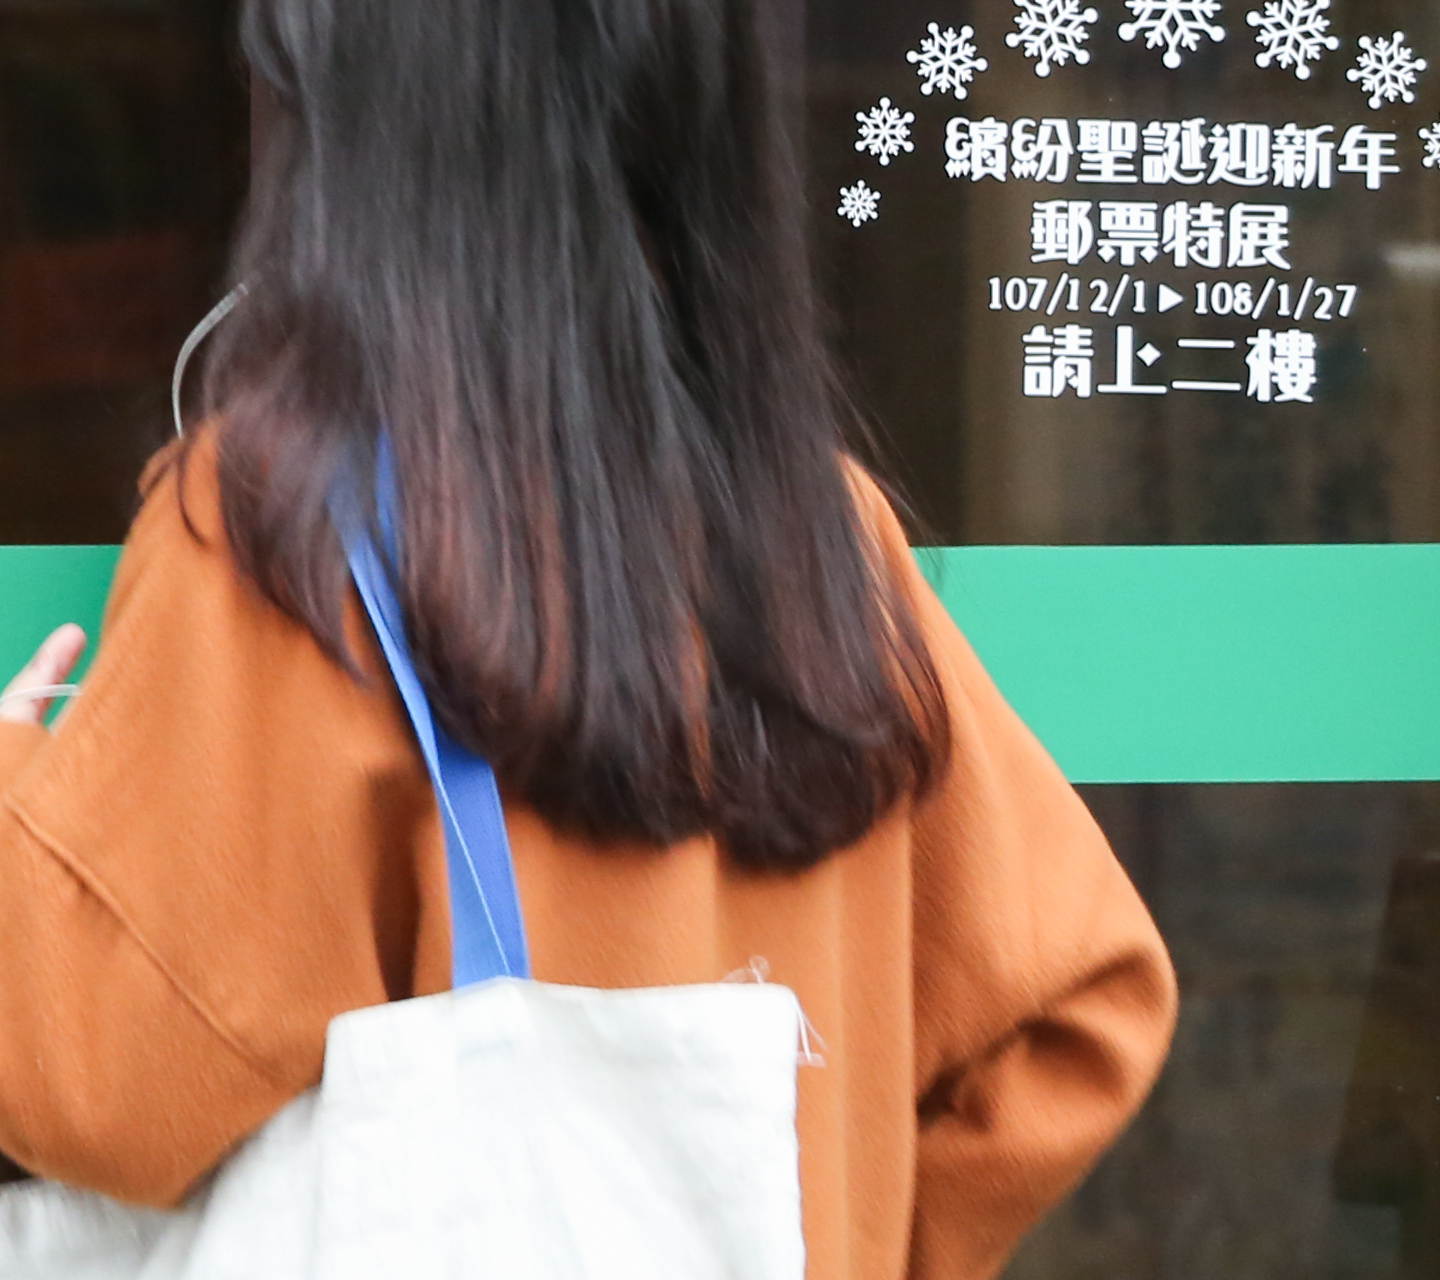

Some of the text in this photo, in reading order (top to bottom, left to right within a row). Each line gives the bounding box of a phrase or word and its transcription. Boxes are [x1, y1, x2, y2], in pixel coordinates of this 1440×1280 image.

[943, 116, 1401, 191] 繽紛聖誕迎新年
[1029, 199, 1293, 271] 郵票特展
[1021, 323, 1318, 404] 請上二樓
